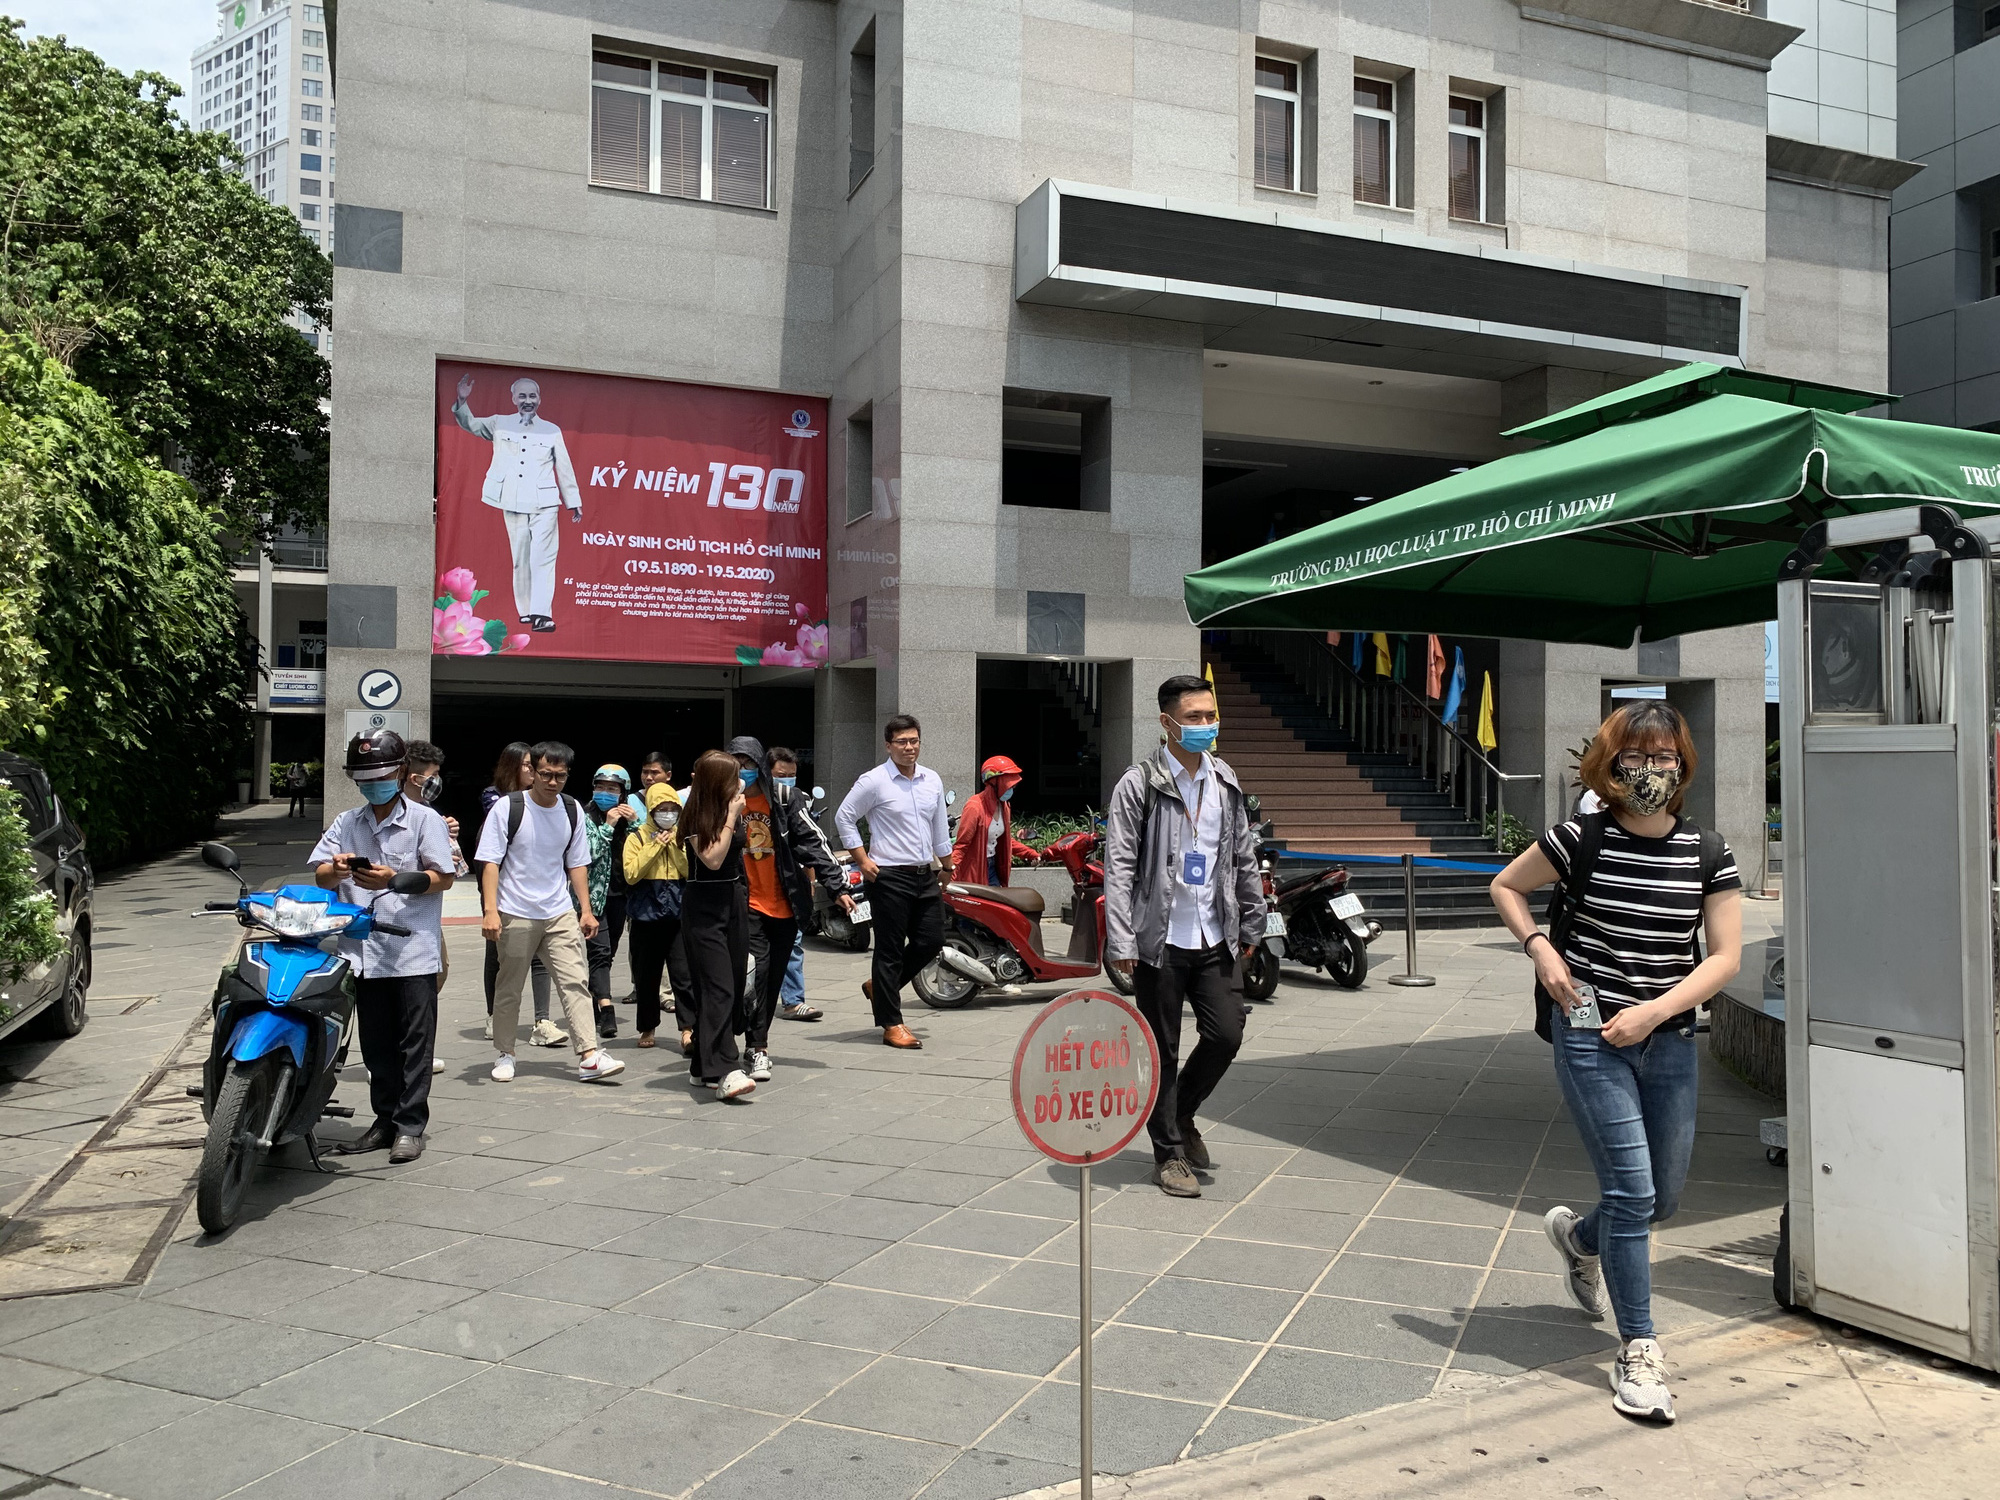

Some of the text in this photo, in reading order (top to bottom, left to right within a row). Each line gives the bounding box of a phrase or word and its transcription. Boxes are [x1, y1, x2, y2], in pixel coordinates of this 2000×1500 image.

[590, 460, 805, 512] KỶ NIỆM 130
[772, 500, 800, 514] NĂM
[582, 530, 821, 560] NGÀY SINH CHỦ TỊCH HỒ CHÍ MINH
[1269, 492, 1617, 587] TRƯỜNG ĐẠI HỌC LUẬT TP. HỒ CHÍ MINH
[624, 559, 697, 576] (19.5.1890
[706, 564, 775, 584] 19.5.2020)
[1045, 1025, 1130, 1072] HẾT CHỖ
[1034, 1079, 1139, 1124] ĐỖ XE ÔTÔ
